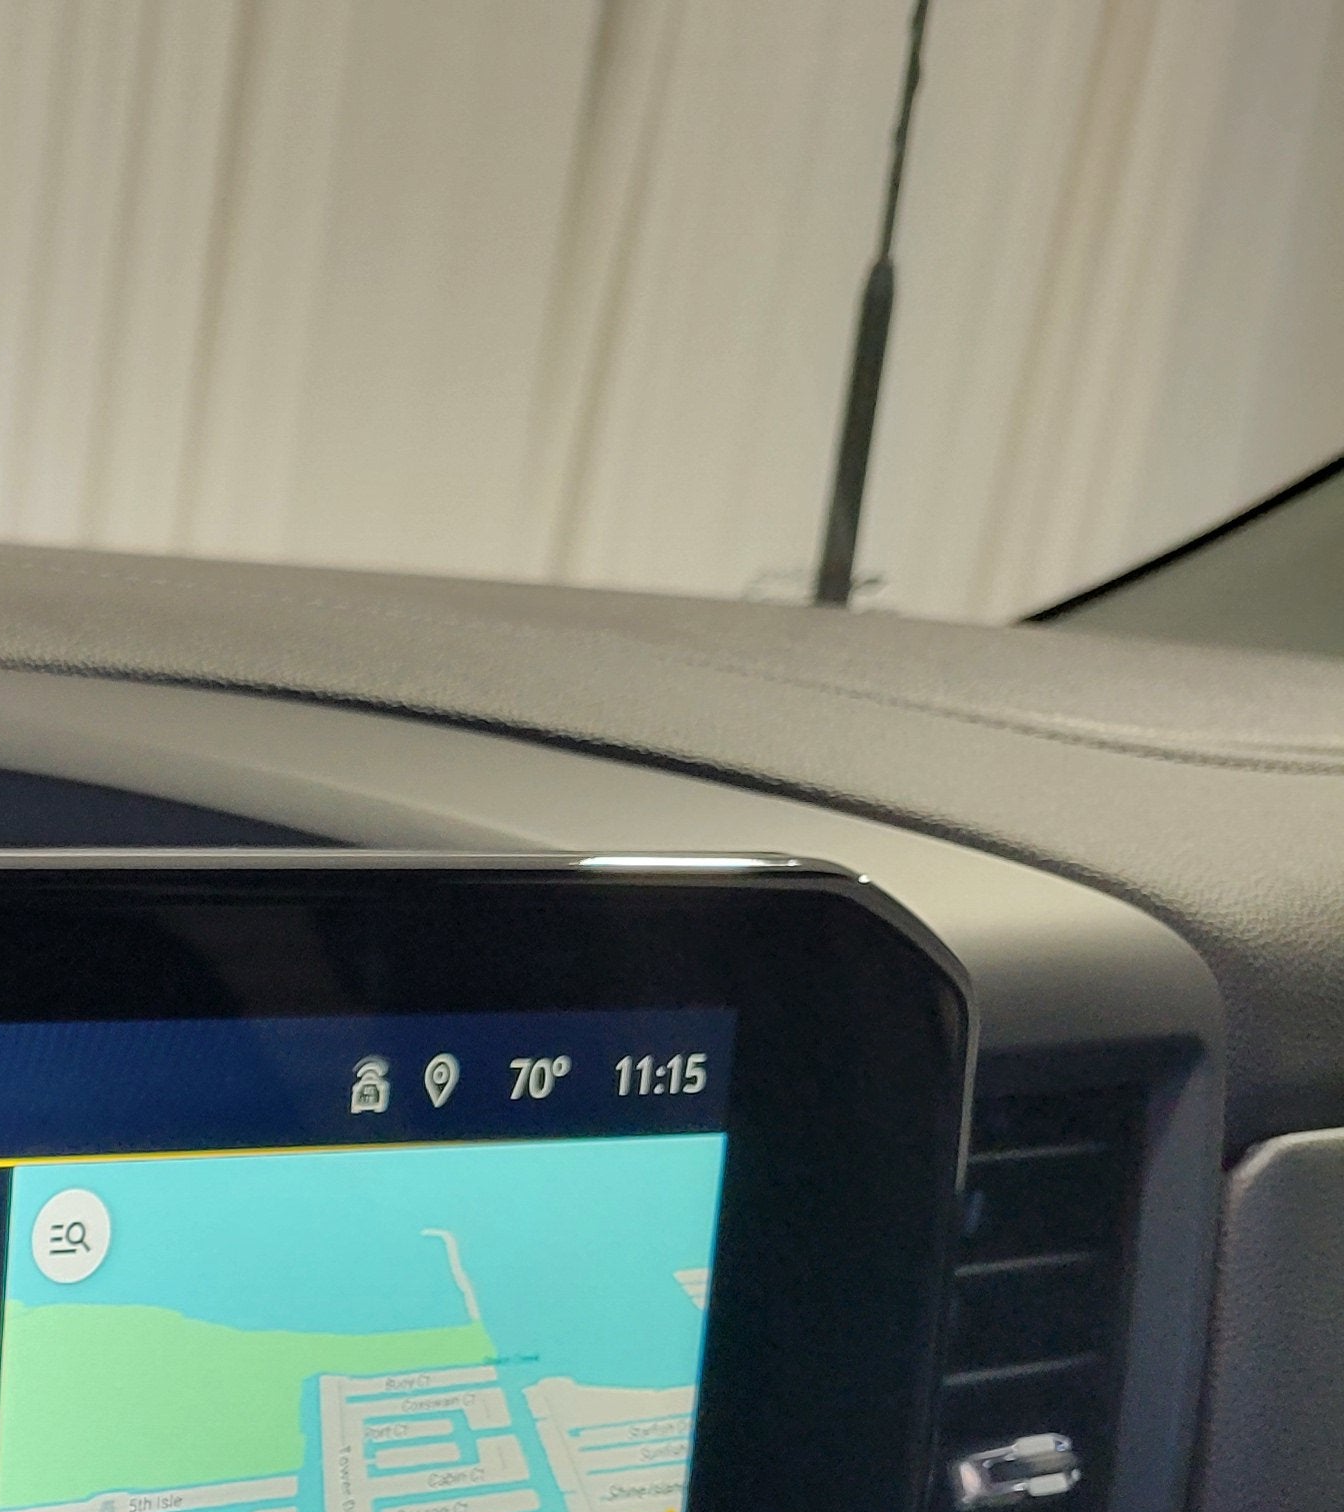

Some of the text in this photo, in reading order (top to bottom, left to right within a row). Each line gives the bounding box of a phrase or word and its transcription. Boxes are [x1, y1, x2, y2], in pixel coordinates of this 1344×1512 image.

[614, 1052, 707, 1097] 11:15
[339, 1445, 352, 1496] Tower
[157, 1495, 183, 1510] Isle
